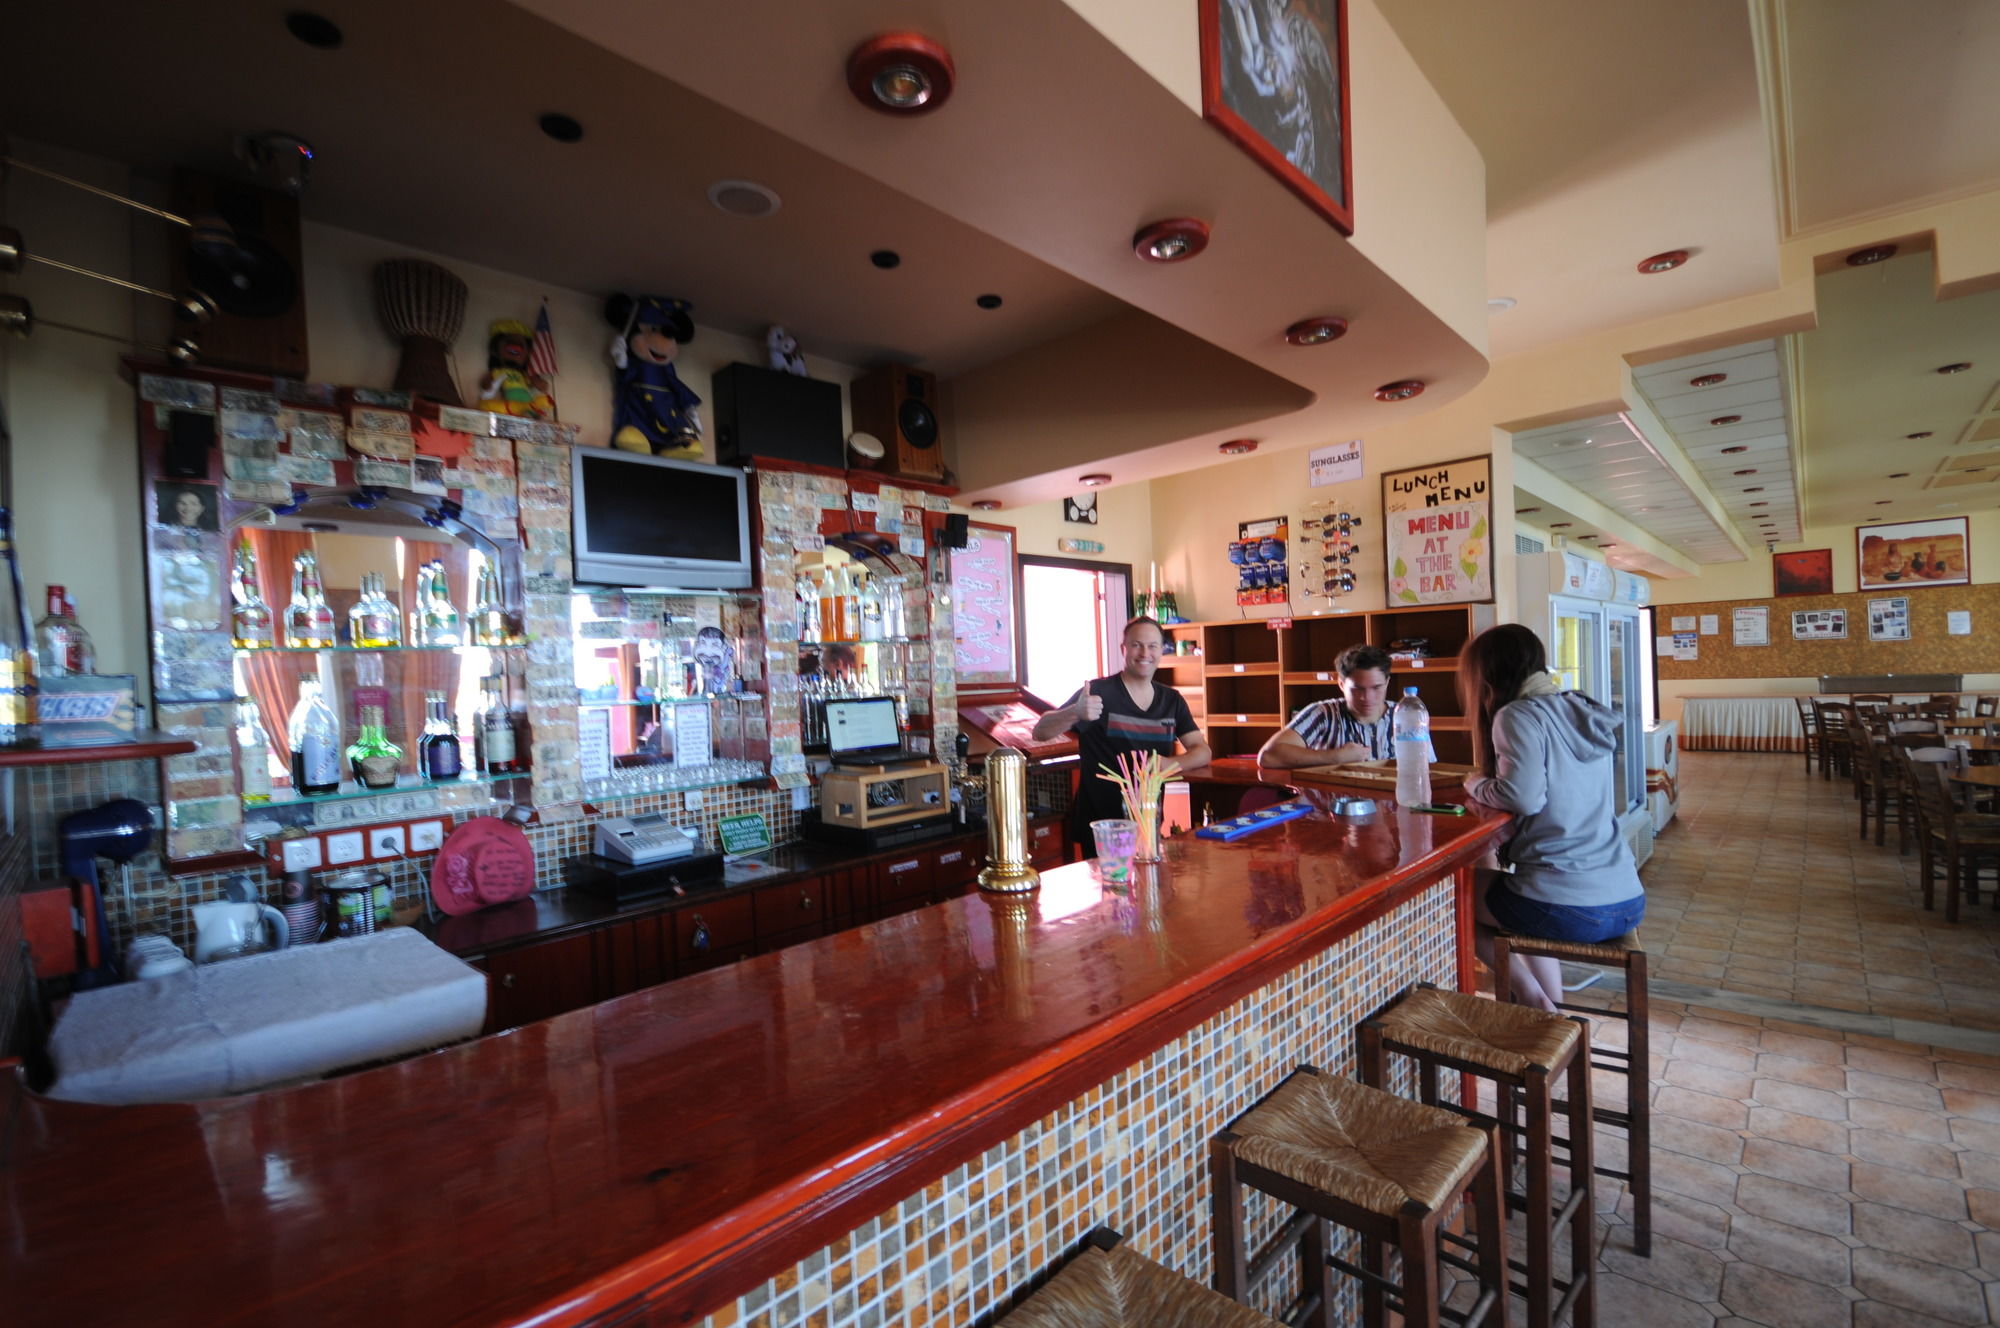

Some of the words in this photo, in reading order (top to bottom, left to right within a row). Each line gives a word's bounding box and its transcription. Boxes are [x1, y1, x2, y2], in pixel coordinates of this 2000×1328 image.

[1310, 451, 1360, 469] SUNGLASSES
[1393, 470, 1449, 493] LUNCH
[1425, 480, 1485, 508] MENU
[1408, 511, 1470, 536] MENU
[1423, 536, 1449, 554] AT
[1416, 554, 1453, 573] THE
[1420, 574, 1457, 593] BAR
